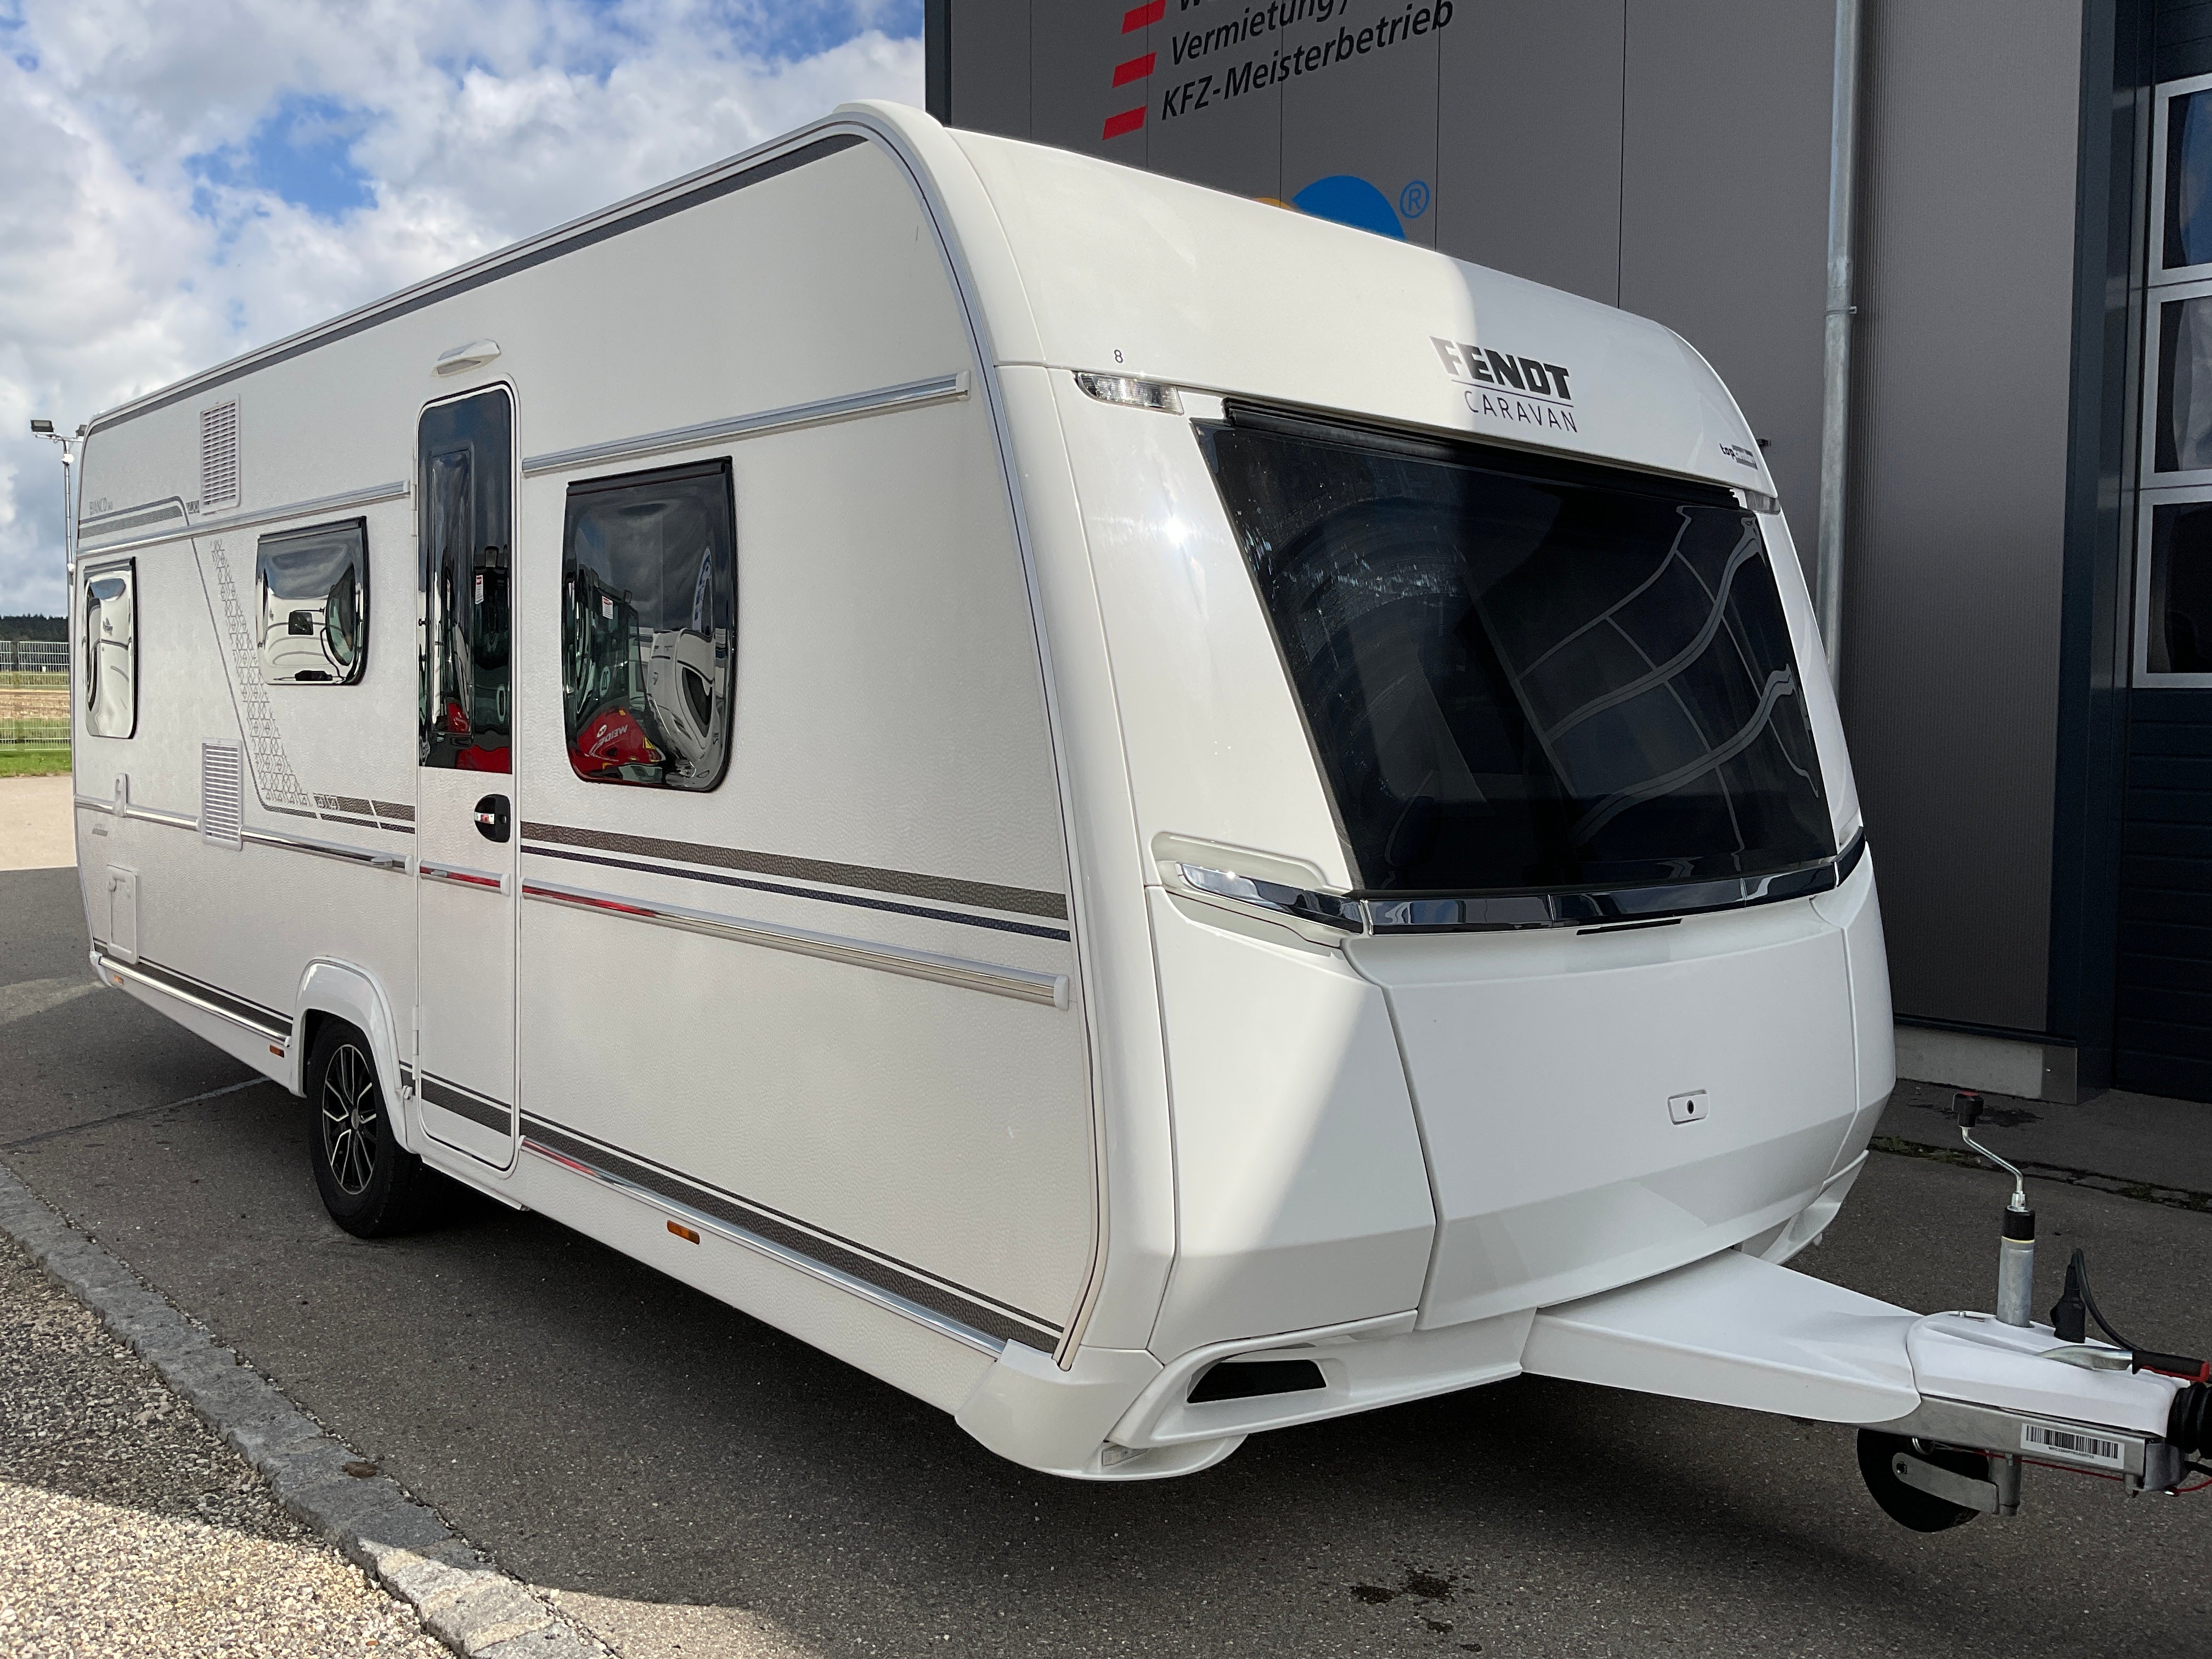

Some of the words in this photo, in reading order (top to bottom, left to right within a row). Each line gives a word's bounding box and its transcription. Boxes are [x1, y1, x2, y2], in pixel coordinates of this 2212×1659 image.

[1161, 0, 1453, 120] KFZ-Meisterbetrieb
[1172, 0, 1348, 65] Vermietung
[1114, 349, 1124, 363] 8
[1429, 336, 1572, 400] FENDT
[1464, 390, 1578, 433] CARAVAN
